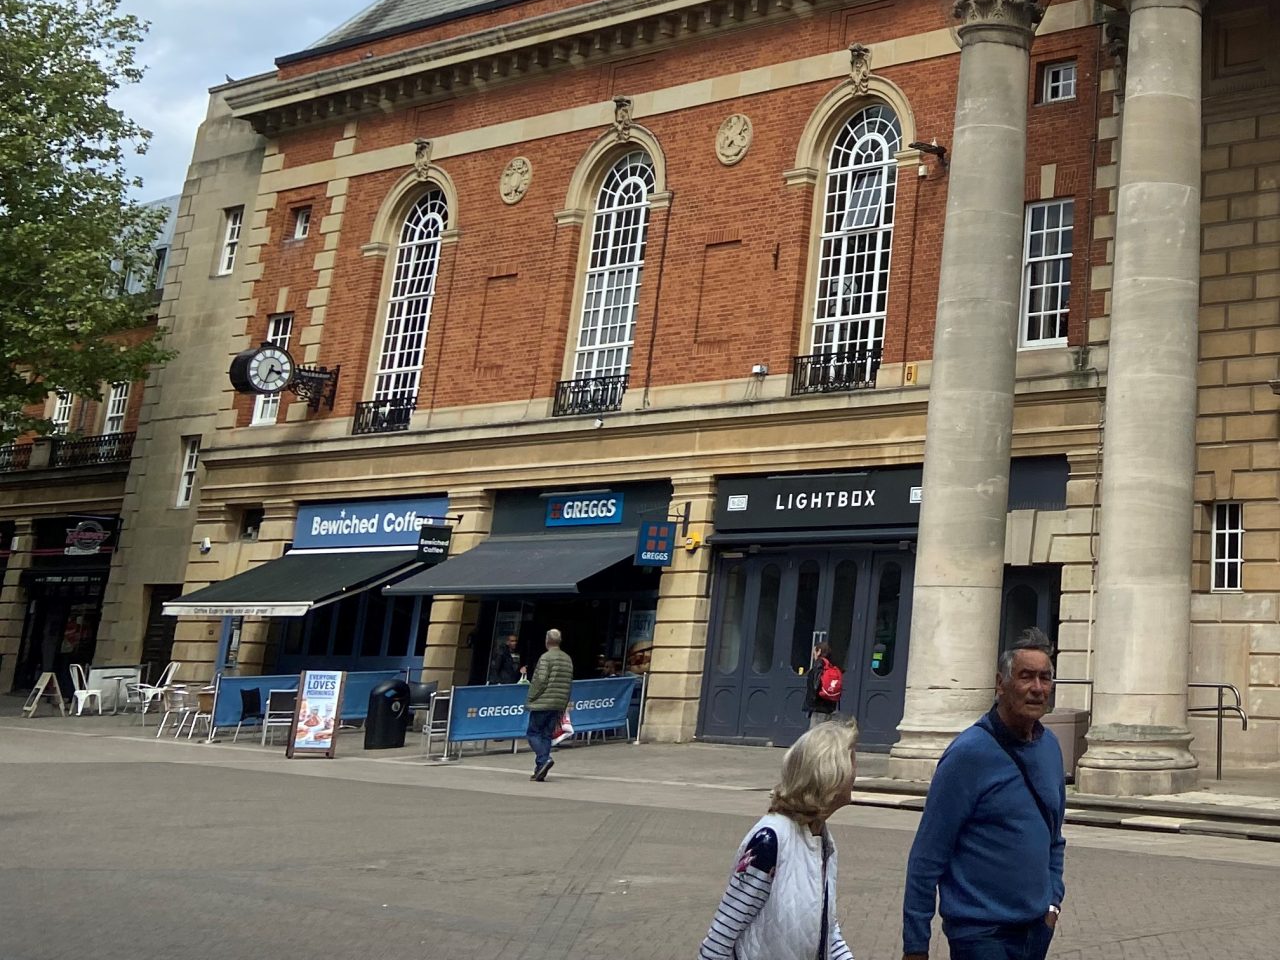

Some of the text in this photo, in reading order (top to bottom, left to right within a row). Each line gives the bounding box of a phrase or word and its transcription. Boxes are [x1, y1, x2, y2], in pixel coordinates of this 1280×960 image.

[776, 489, 876, 510] LIGHTBOX
[563, 499, 616, 518] GREGGS
[311, 508, 379, 536] Bewiched
[641, 551, 668, 560] GREGGS
[307, 680, 336, 690] LOVES
[478, 704, 525, 718] GREGGS
[575, 697, 615, 711] GREGGS
